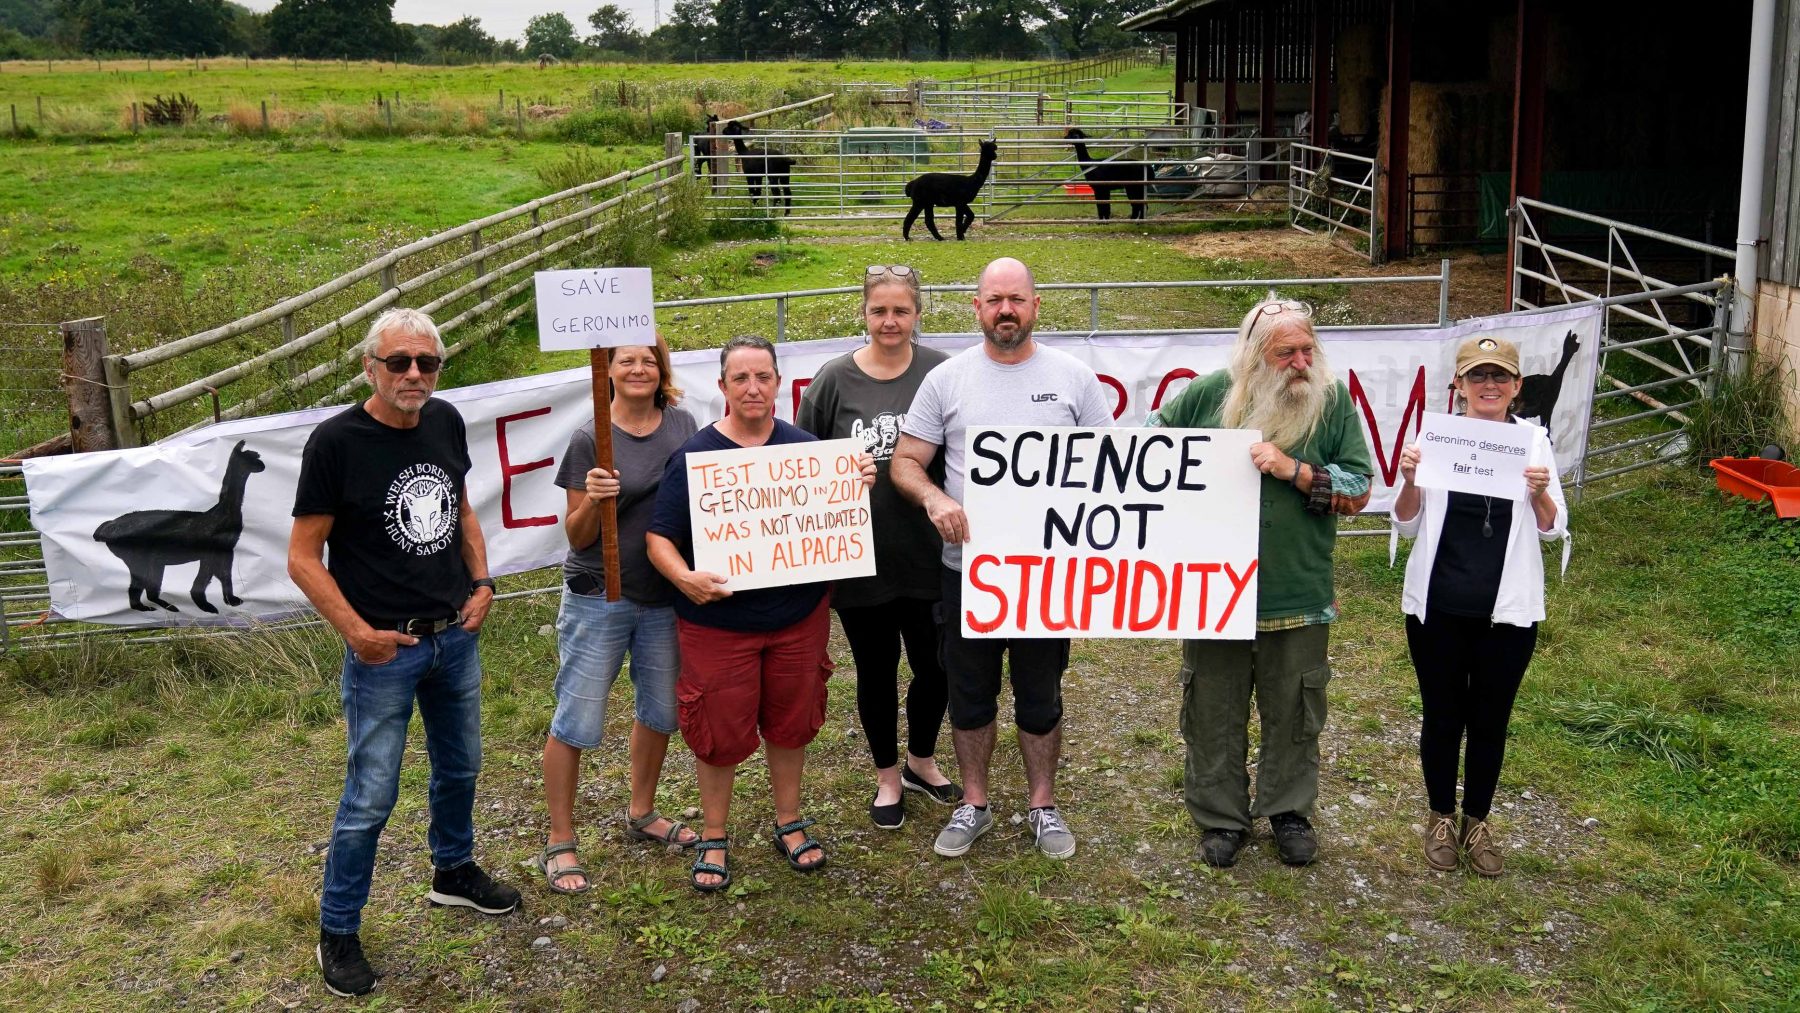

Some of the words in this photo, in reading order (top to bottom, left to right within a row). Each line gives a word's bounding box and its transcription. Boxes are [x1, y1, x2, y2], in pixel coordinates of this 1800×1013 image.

[561, 277, 621, 297] SAVE
[552, 314, 650, 333] GERONIMO
[1031, 393, 1058, 402] USC
[970, 430, 1212, 494] SCIENCE
[1425, 431, 1476, 447] Geronimo
[1478, 440, 1526, 456] deserves
[385, 466, 415, 505] WELSH
[415, 463, 454, 491] BORDER
[691, 462, 756, 489] TEST
[768, 457, 821, 482] USED
[1453, 462, 1472, 474] fair
[1474, 466, 1494, 477] test
[699, 484, 809, 517] GERONIMO
[814, 486, 828, 496] IN
[827, 478, 865, 504] 2017
[384, 523, 414, 553] HUNT
[416, 507, 459, 556] SABOTEURS
[704, 520, 751, 542] WAS
[760, 513, 793, 538] NOT
[795, 507, 869, 533] VALIDATED
[1043, 502, 1165, 551] NOT
[728, 551, 753, 576] IN
[771, 532, 864, 571] ALPACAS
[965, 553, 1259, 633] STUPIDITY
